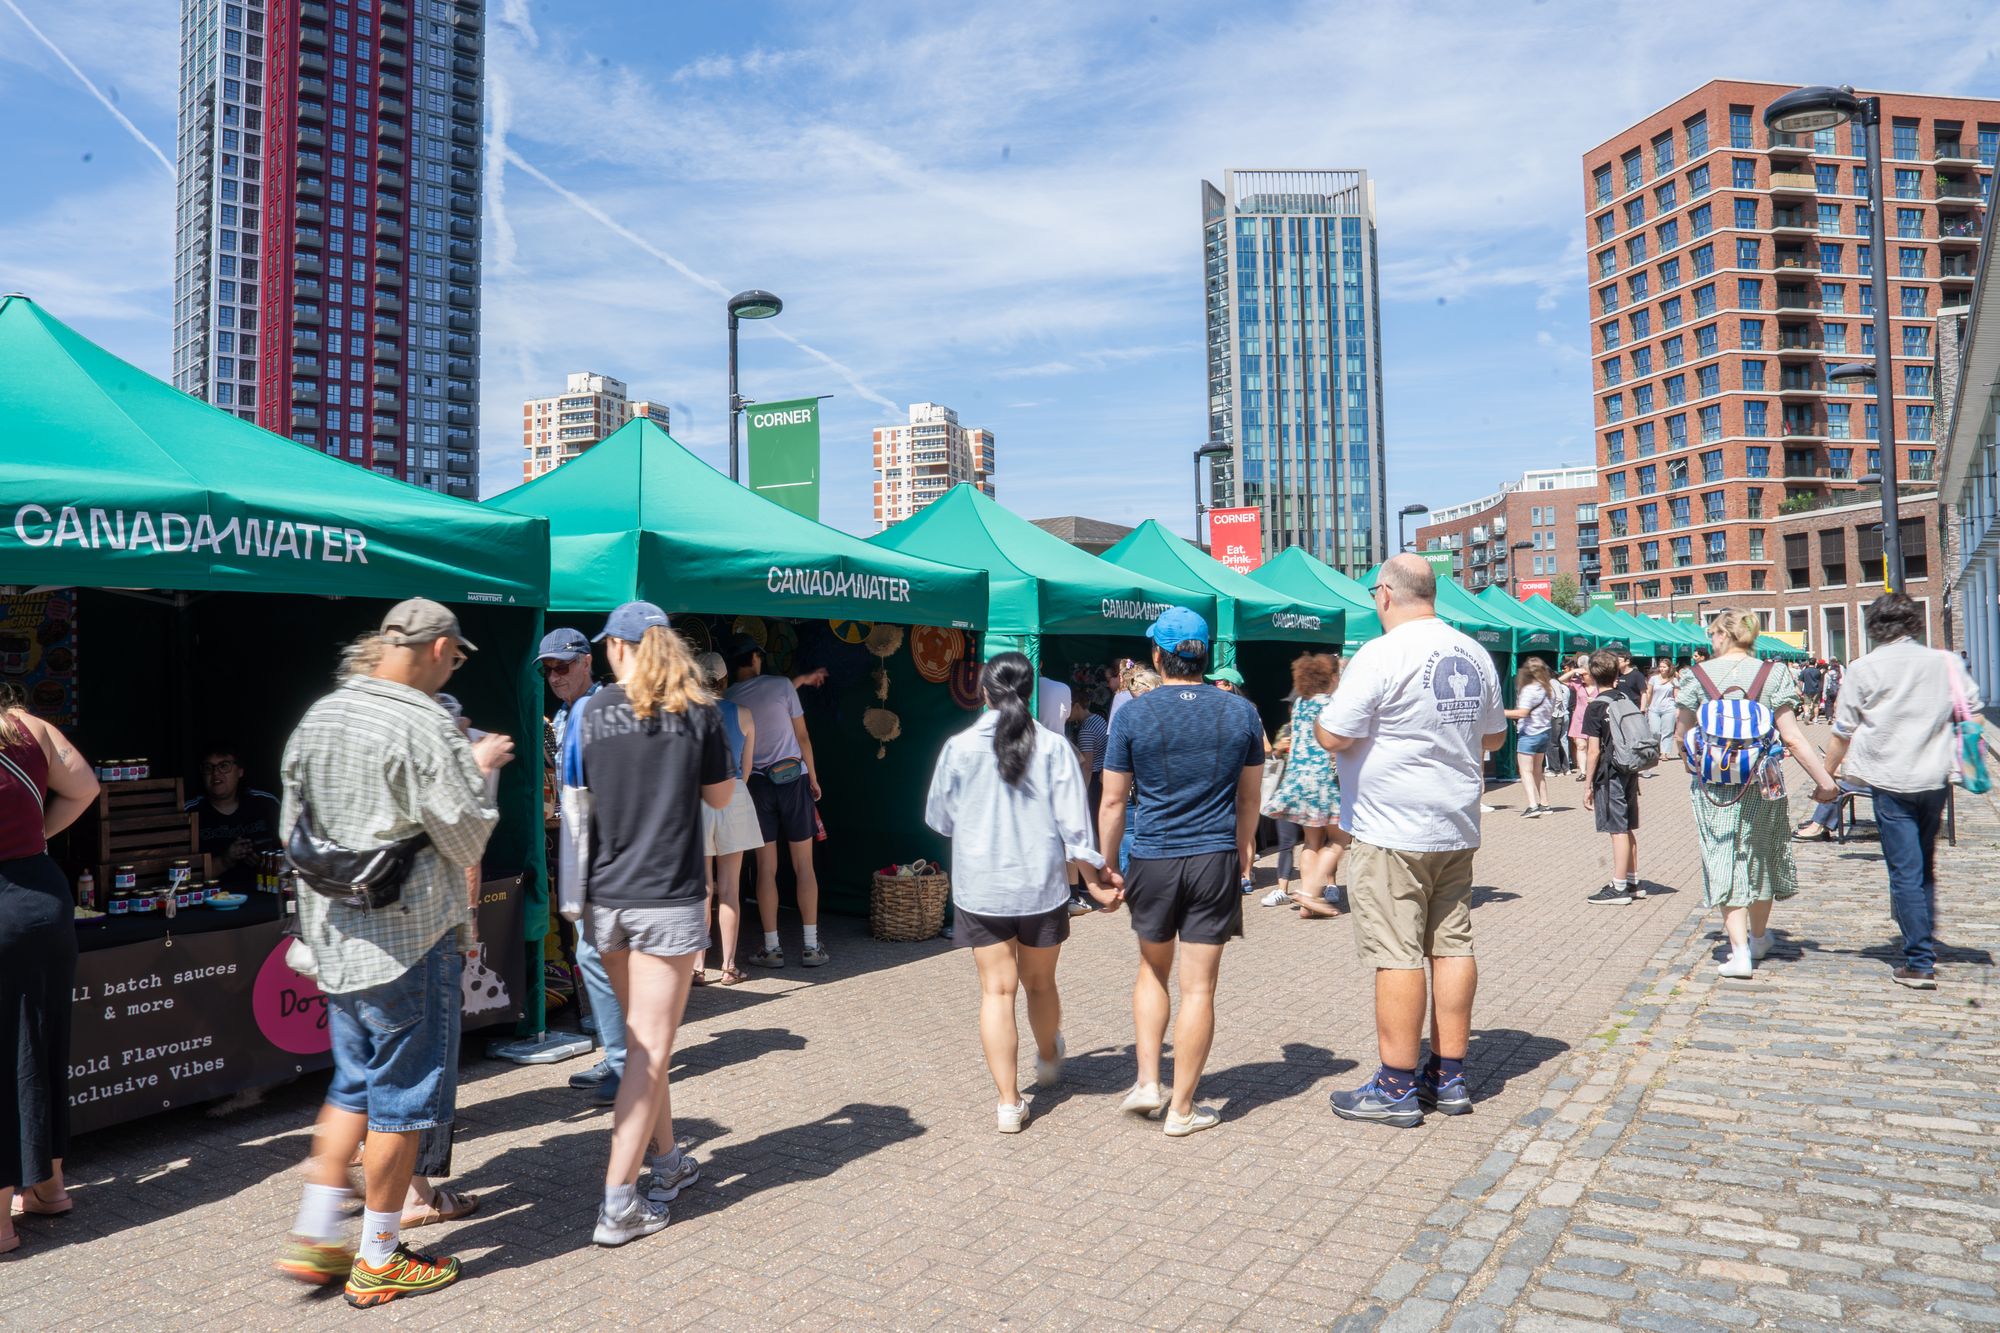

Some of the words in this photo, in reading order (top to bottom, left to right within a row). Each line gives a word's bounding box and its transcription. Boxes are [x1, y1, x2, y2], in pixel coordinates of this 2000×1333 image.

[754, 409, 811, 428] CORNER
[1213, 513, 1256, 525] CORNER
[1226, 545, 1246, 555] Eat.
[1422, 650, 1441, 690] NELLY'S
[1441, 701, 1478, 710] PIZZERIA
[478, 890, 508, 905] .com
[104, 974, 162, 996] batch
[173, 962, 238, 984] sauces
[104, 1006, 116, 1020] &
[127, 997, 175, 1016] more
[122, 1034, 213, 1066] Flavours
[68, 1074, 159, 1107] nclusive
[170, 1056, 225, 1081] Vibes
